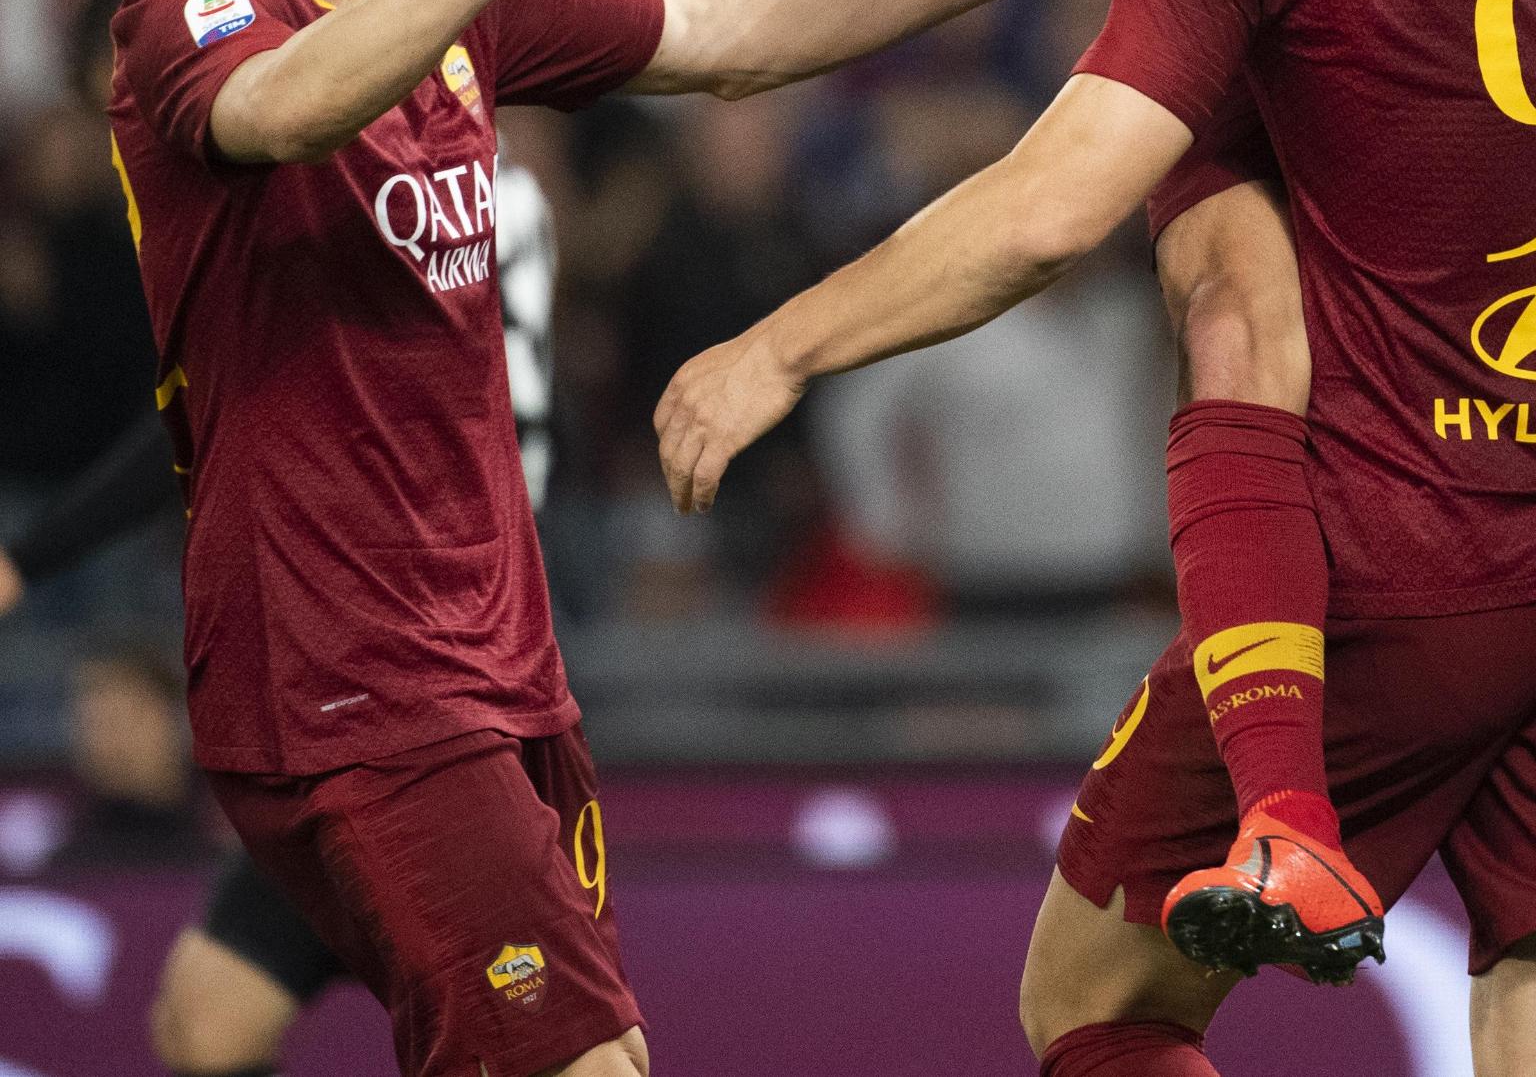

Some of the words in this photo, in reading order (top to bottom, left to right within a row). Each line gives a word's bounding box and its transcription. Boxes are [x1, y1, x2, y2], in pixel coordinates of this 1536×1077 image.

[218, 18, 247, 33] TIM
[374, 152, 498, 262] QATA
[574, 799, 606, 920] 9
[505, 976, 546, 1000] ROMA
